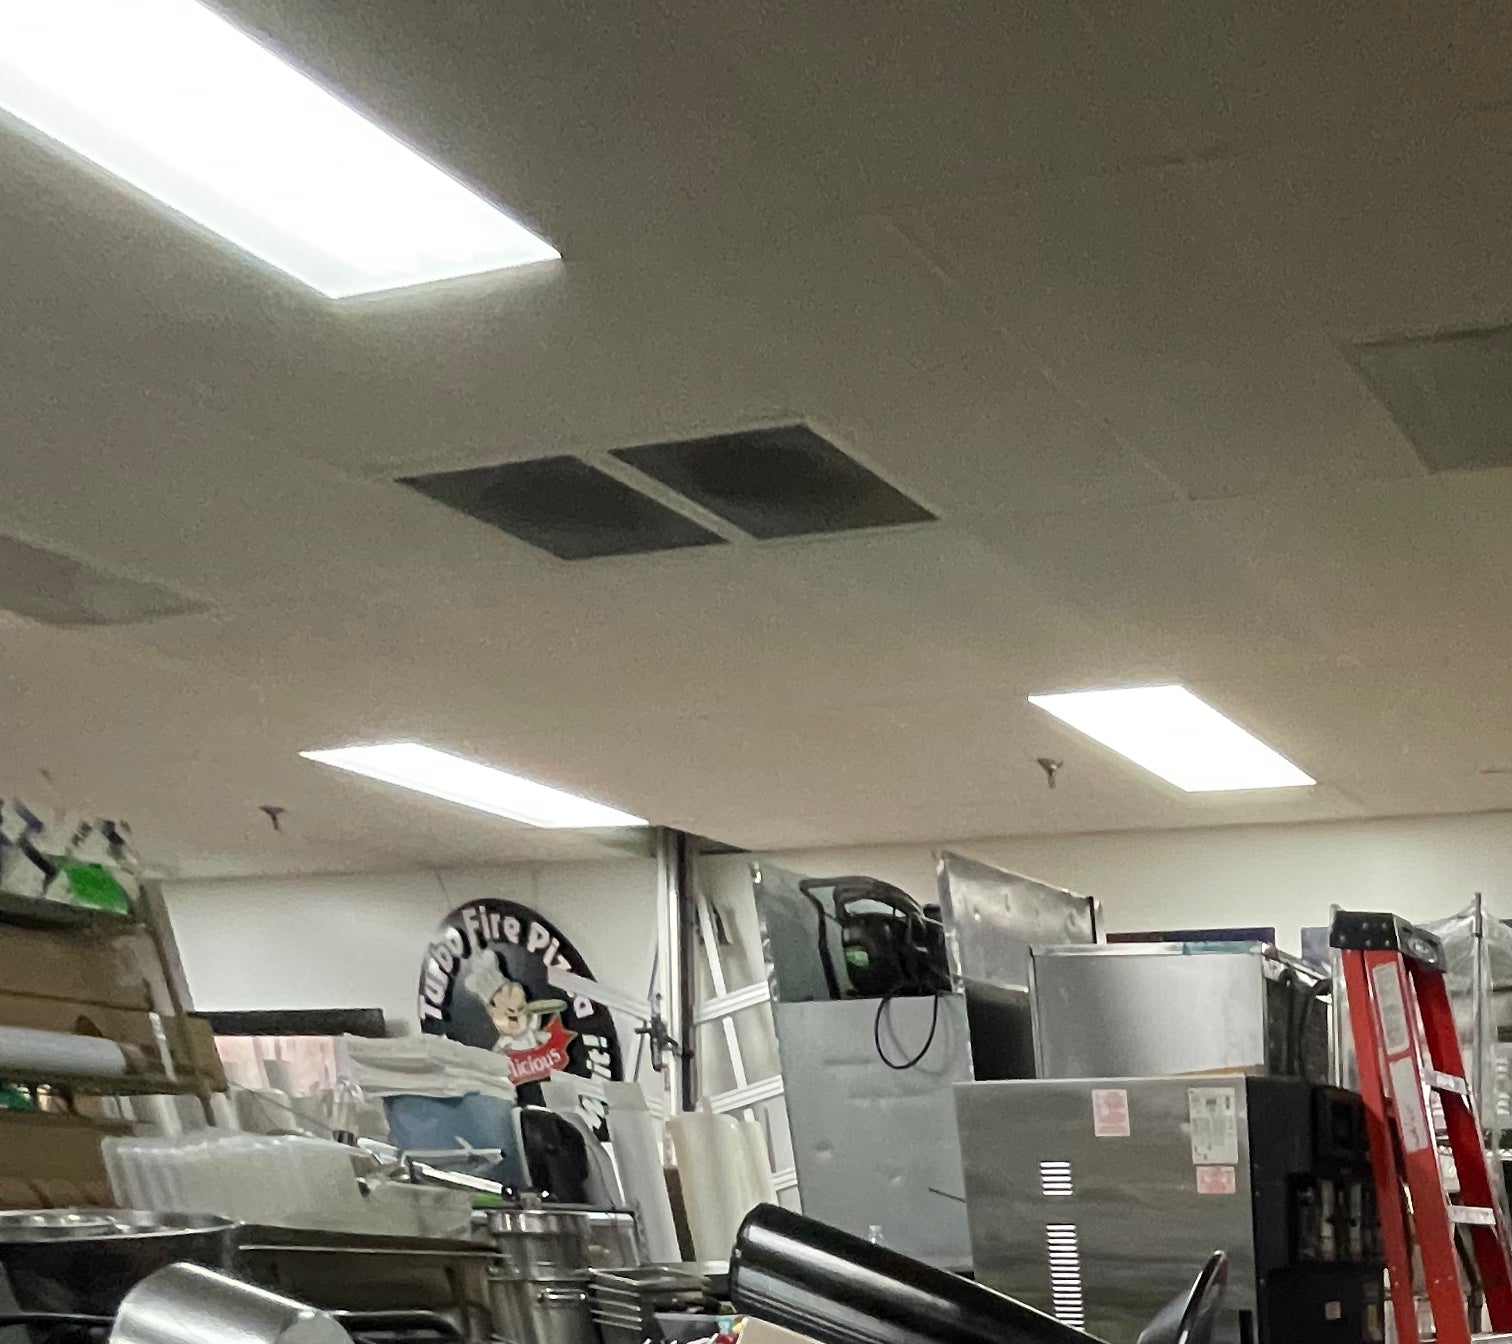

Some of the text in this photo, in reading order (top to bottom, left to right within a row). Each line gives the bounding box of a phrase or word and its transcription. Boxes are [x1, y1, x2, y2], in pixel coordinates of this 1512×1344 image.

[419, 905, 594, 1021] Turbo Fire Piza
[510, 1049, 561, 1078] licious
